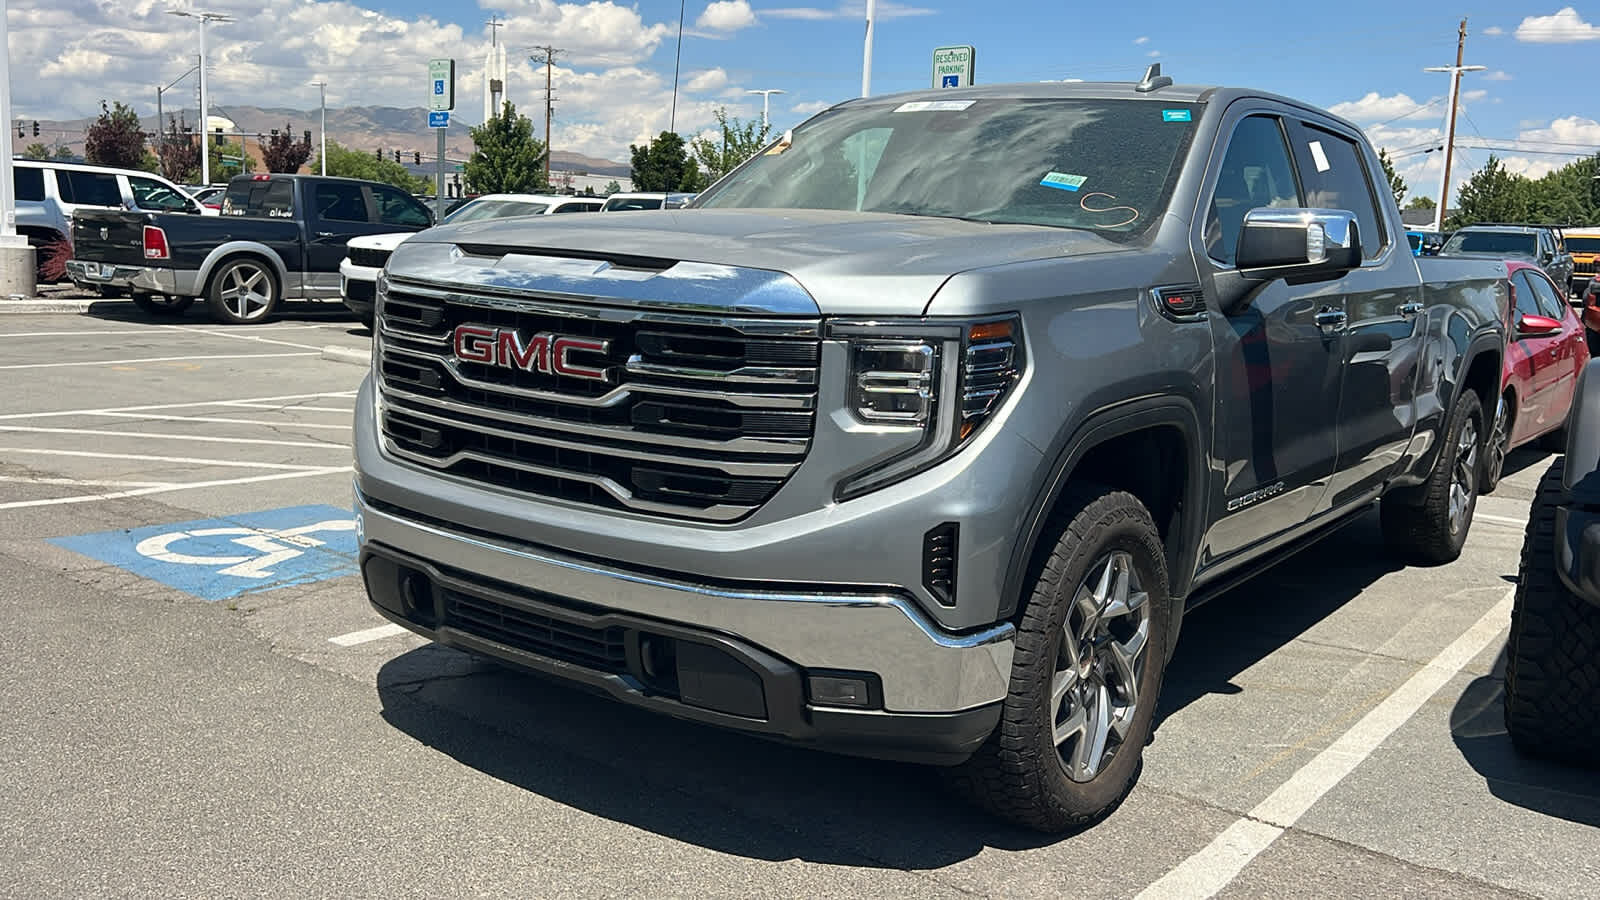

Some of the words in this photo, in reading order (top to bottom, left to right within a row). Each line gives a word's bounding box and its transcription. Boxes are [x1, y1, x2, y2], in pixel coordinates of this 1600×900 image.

[935, 52, 968, 64] RESERVED
[938, 64, 965, 74] PARKING
[453, 324, 609, 382] GMC
